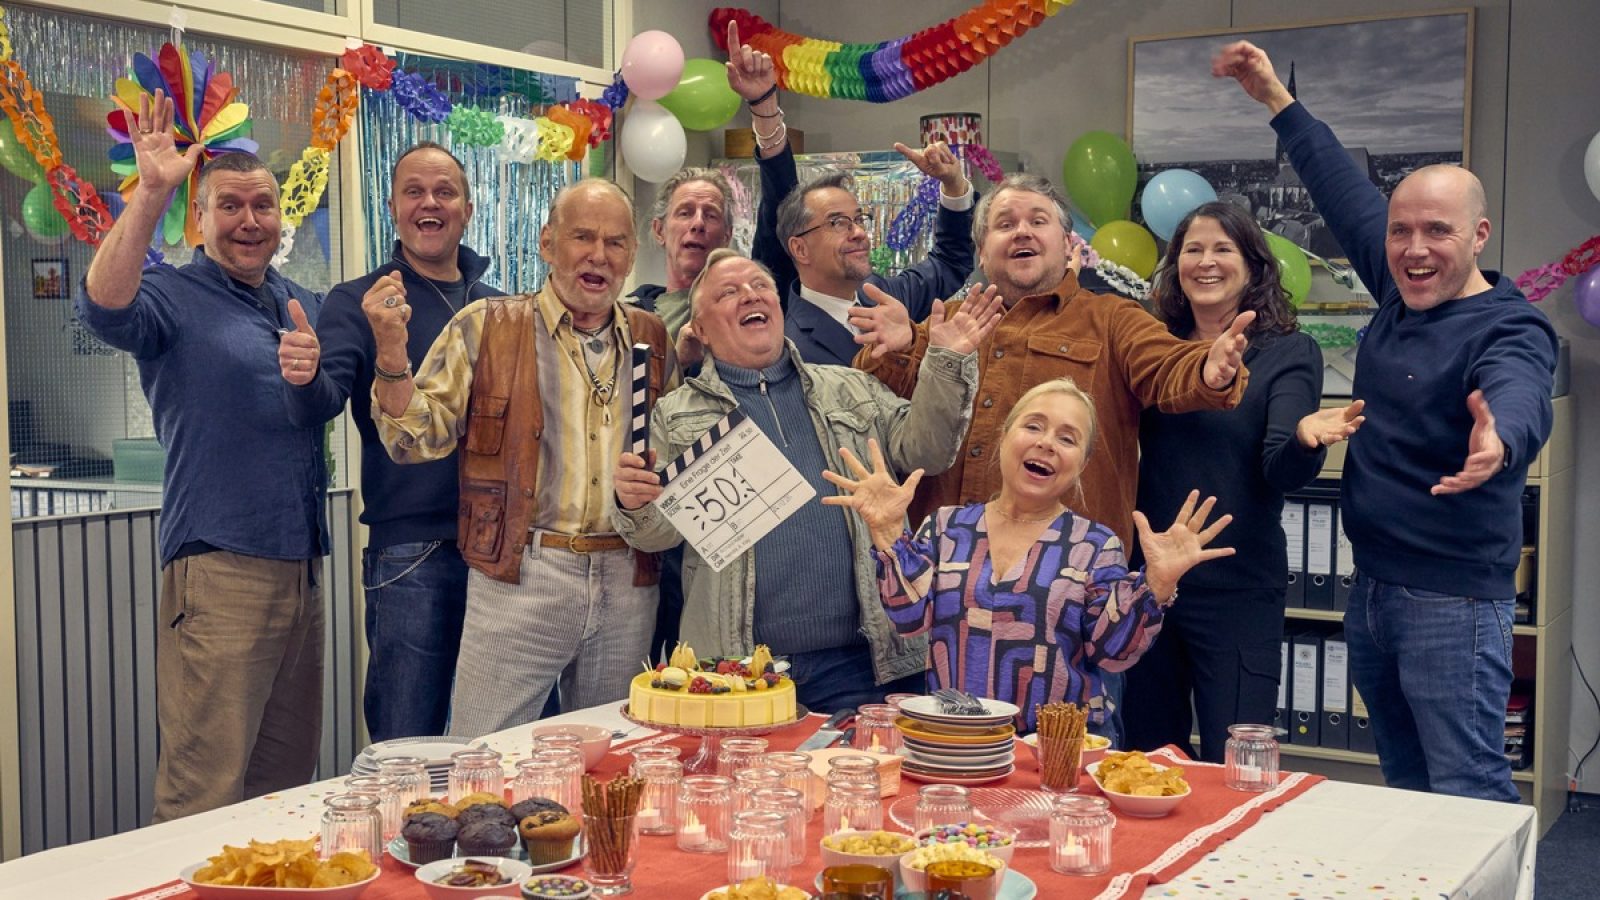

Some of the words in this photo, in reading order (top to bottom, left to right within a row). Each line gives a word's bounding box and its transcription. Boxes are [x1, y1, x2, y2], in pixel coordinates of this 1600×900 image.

[680, 473, 697, 489] Eine
[692, 460, 712, 480] Frage
[710, 452, 726, 466] der
[719, 443, 732, 456] Zeit
